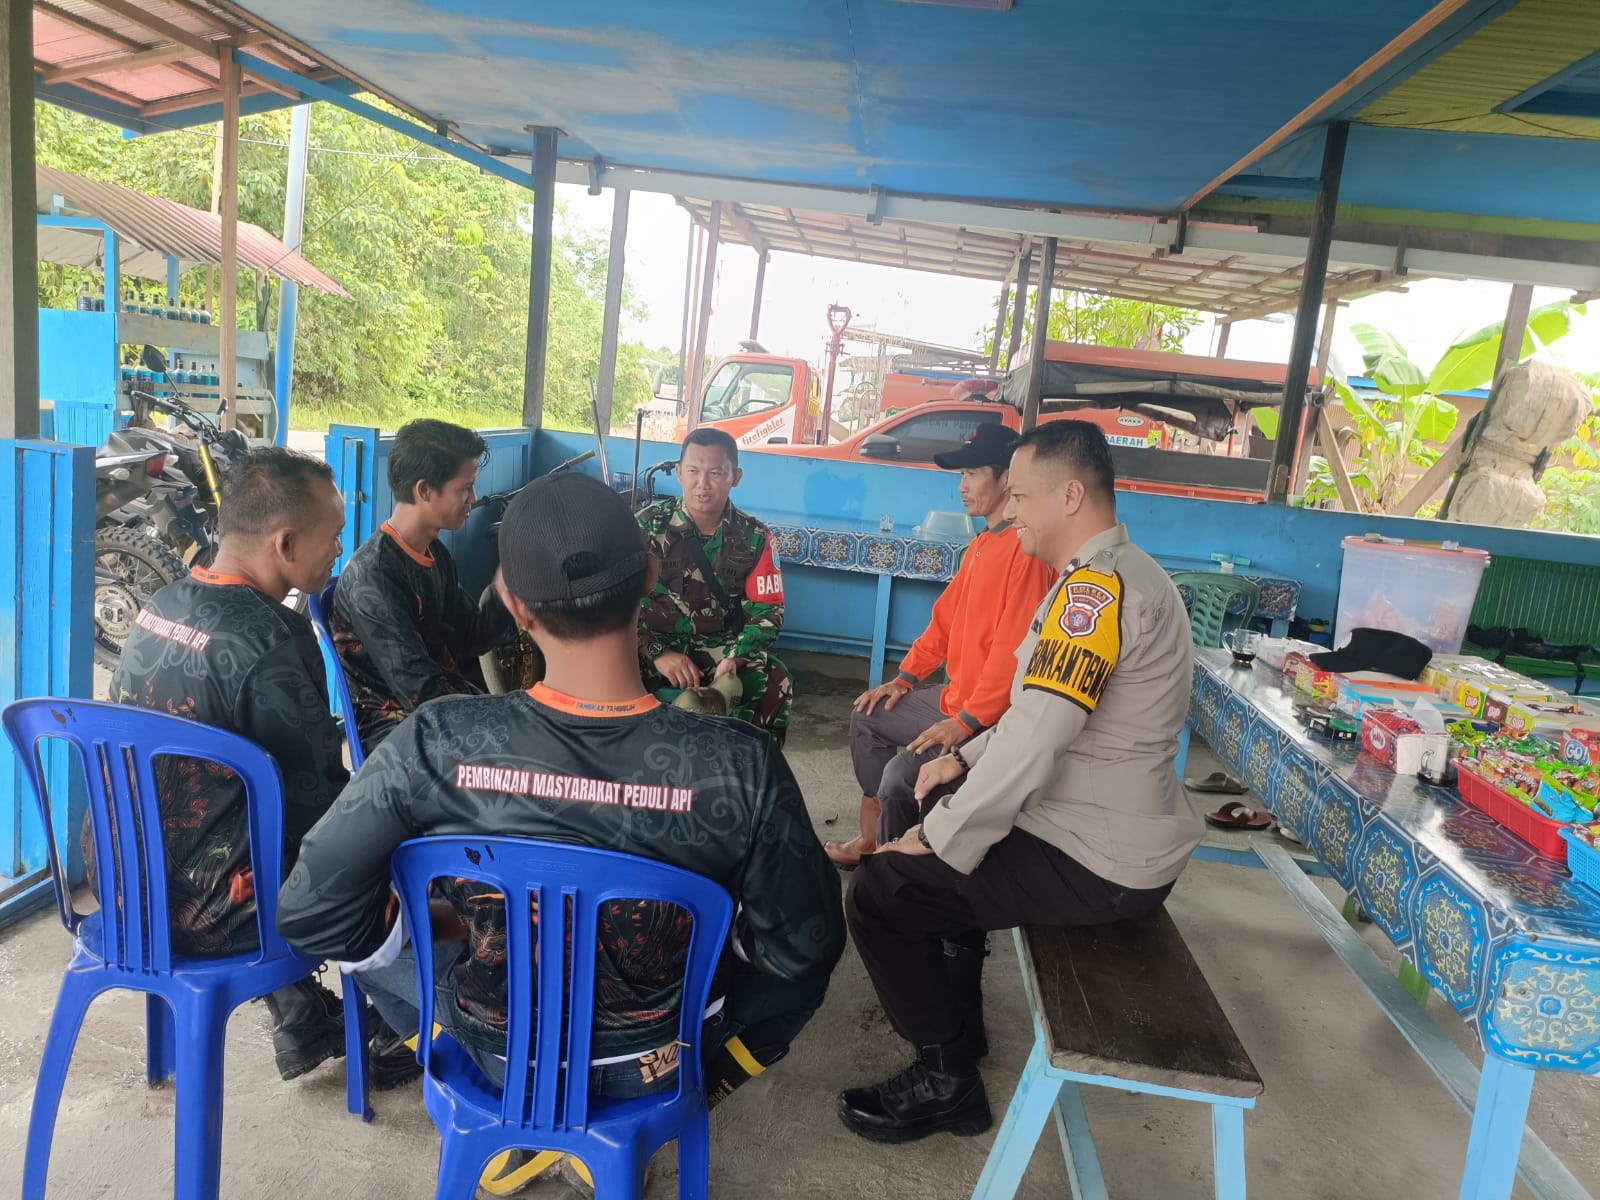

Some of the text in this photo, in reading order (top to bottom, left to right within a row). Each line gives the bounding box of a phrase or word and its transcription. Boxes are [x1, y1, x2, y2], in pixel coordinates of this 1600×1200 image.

[742, 417, 784, 445] firefighter
[191, 631, 211, 651] API
[456, 764, 693, 812] PEMBINAAN MASYARAKAT PEDULI API
